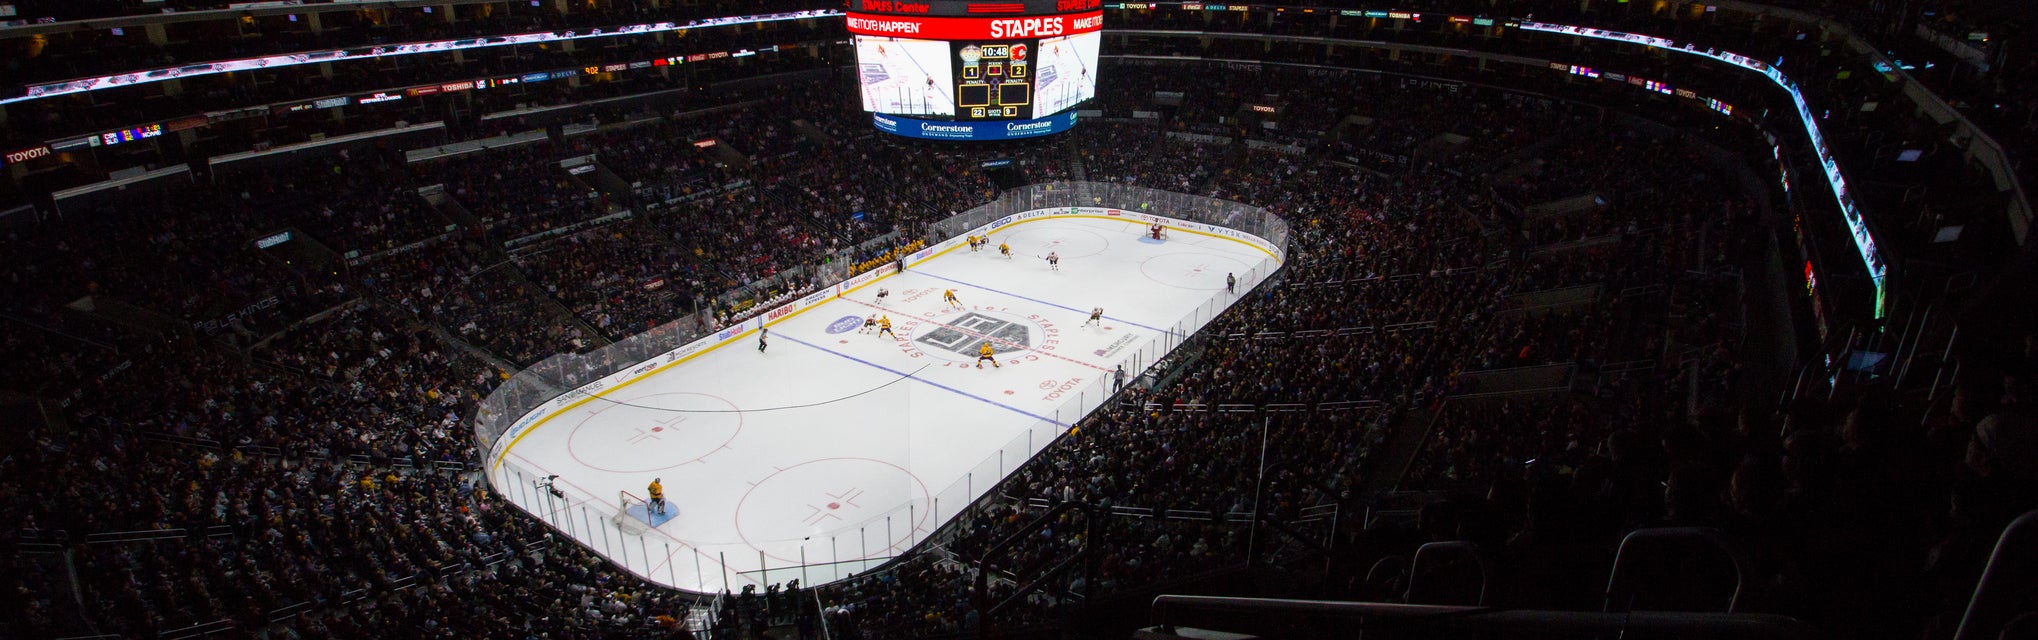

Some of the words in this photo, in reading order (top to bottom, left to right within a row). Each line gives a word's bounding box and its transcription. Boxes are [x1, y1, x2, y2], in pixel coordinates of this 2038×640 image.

[862, 0, 893, 12] STAPLES
[895, 1, 930, 13] Center
[858, 18, 878, 31] more
[878, 20, 920, 33] HAPPEN
[990, 17, 1063, 38] STAPLES
[1073, 16, 1092, 30] MAKE
[983, 47, 1007, 56] 10:48
[969, 68, 974, 76] 1
[1016, 66, 1022, 75] 2
[441, 82, 474, 92] TOSHIBA
[1253, 105, 1275, 113] TOYOTA
[921, 122, 973, 132] Cornerstone
[1006, 121, 1052, 131] Cornerstone
[6, 145, 51, 164] TOYOTA
[1023, 210, 1045, 219] DELTA
[1149, 215, 1170, 225] TOYOTA
[991, 217, 1012, 230] GEICO
[767, 305, 793, 321] HARIBO
[1027, 313, 1060, 351] STAPLES
[1042, 376, 1084, 402] TOYOTA
